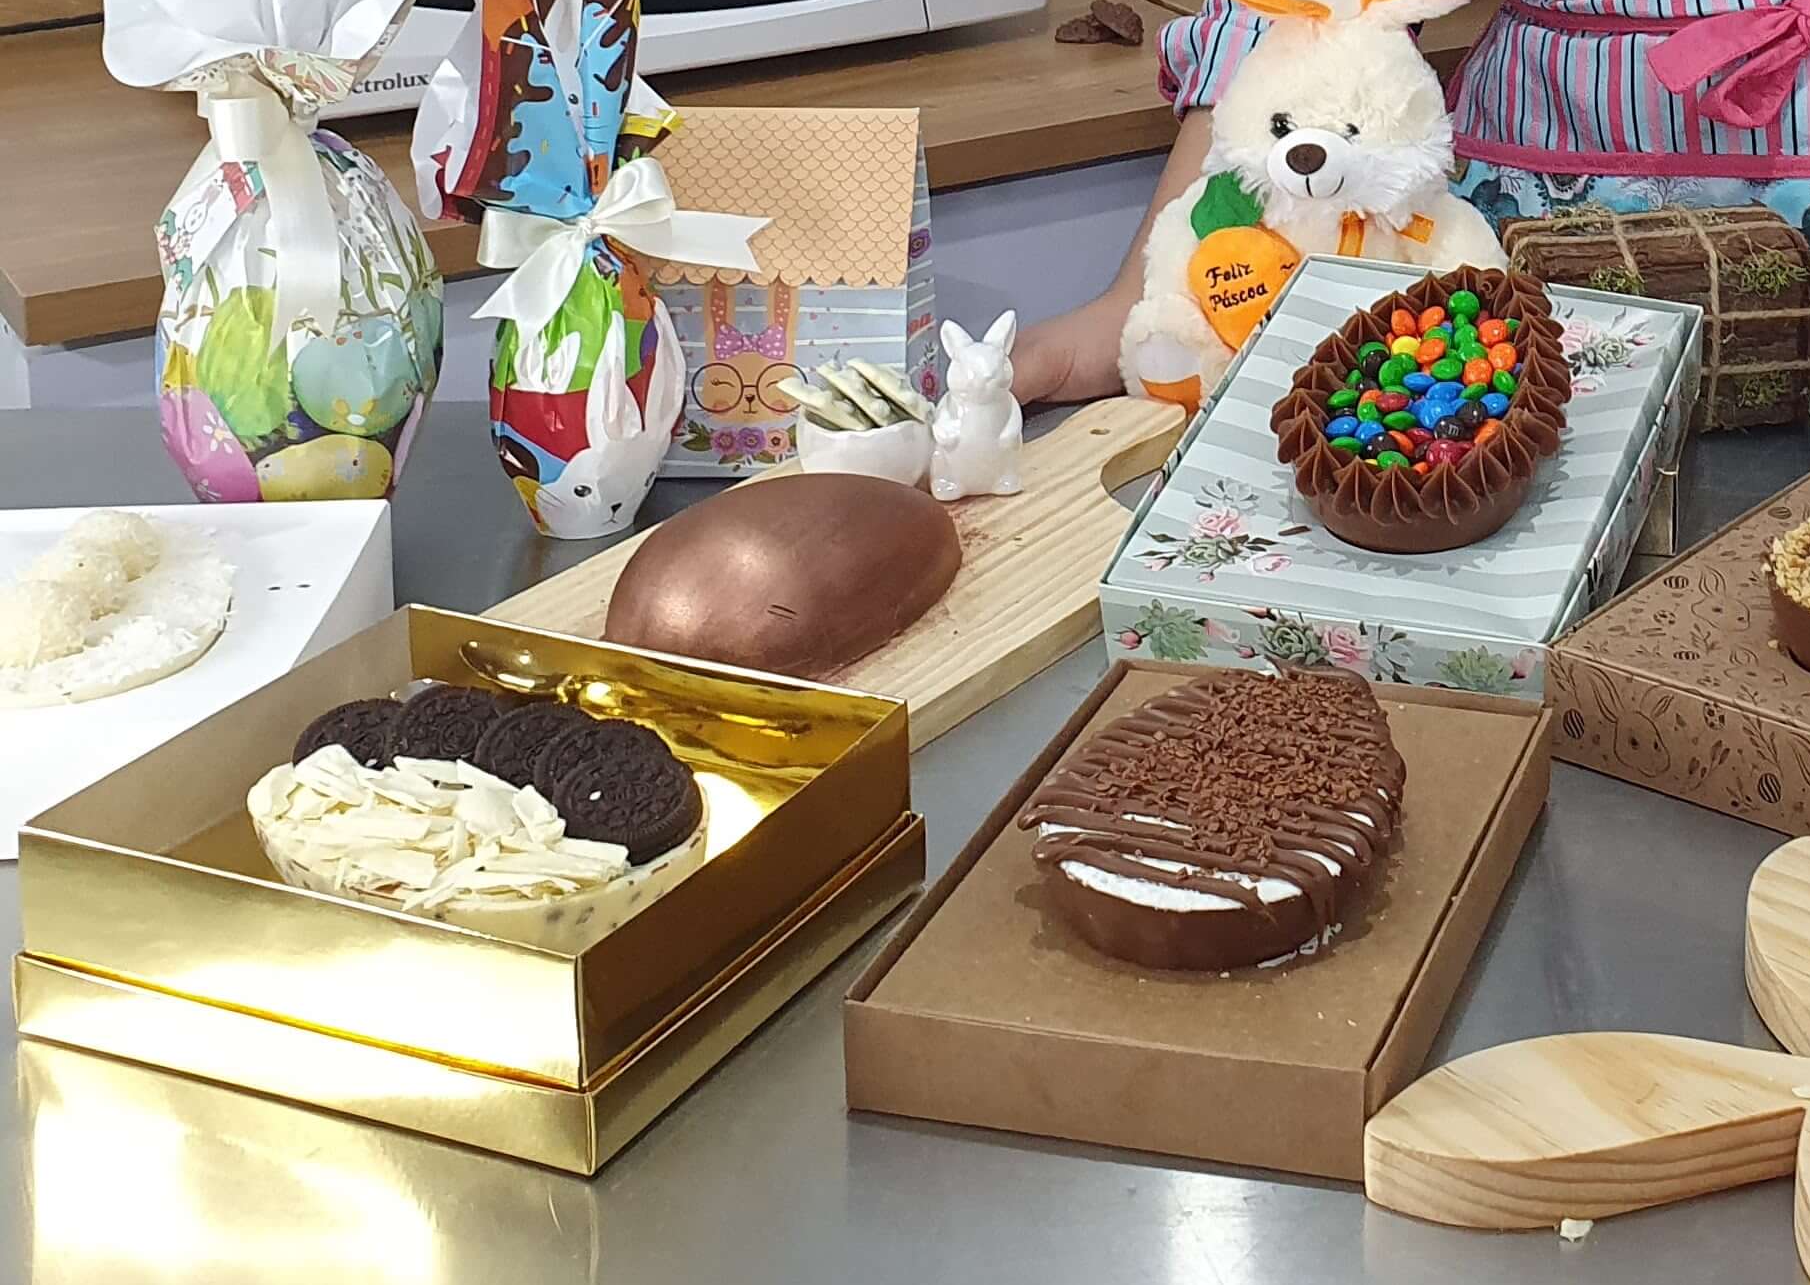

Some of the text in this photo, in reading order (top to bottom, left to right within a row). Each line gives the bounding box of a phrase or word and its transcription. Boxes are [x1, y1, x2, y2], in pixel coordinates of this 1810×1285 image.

[352, 72, 430, 94] ctrolux
[1205, 263, 1254, 288] Feliz
[1209, 282, 1269, 312] Páscoa
